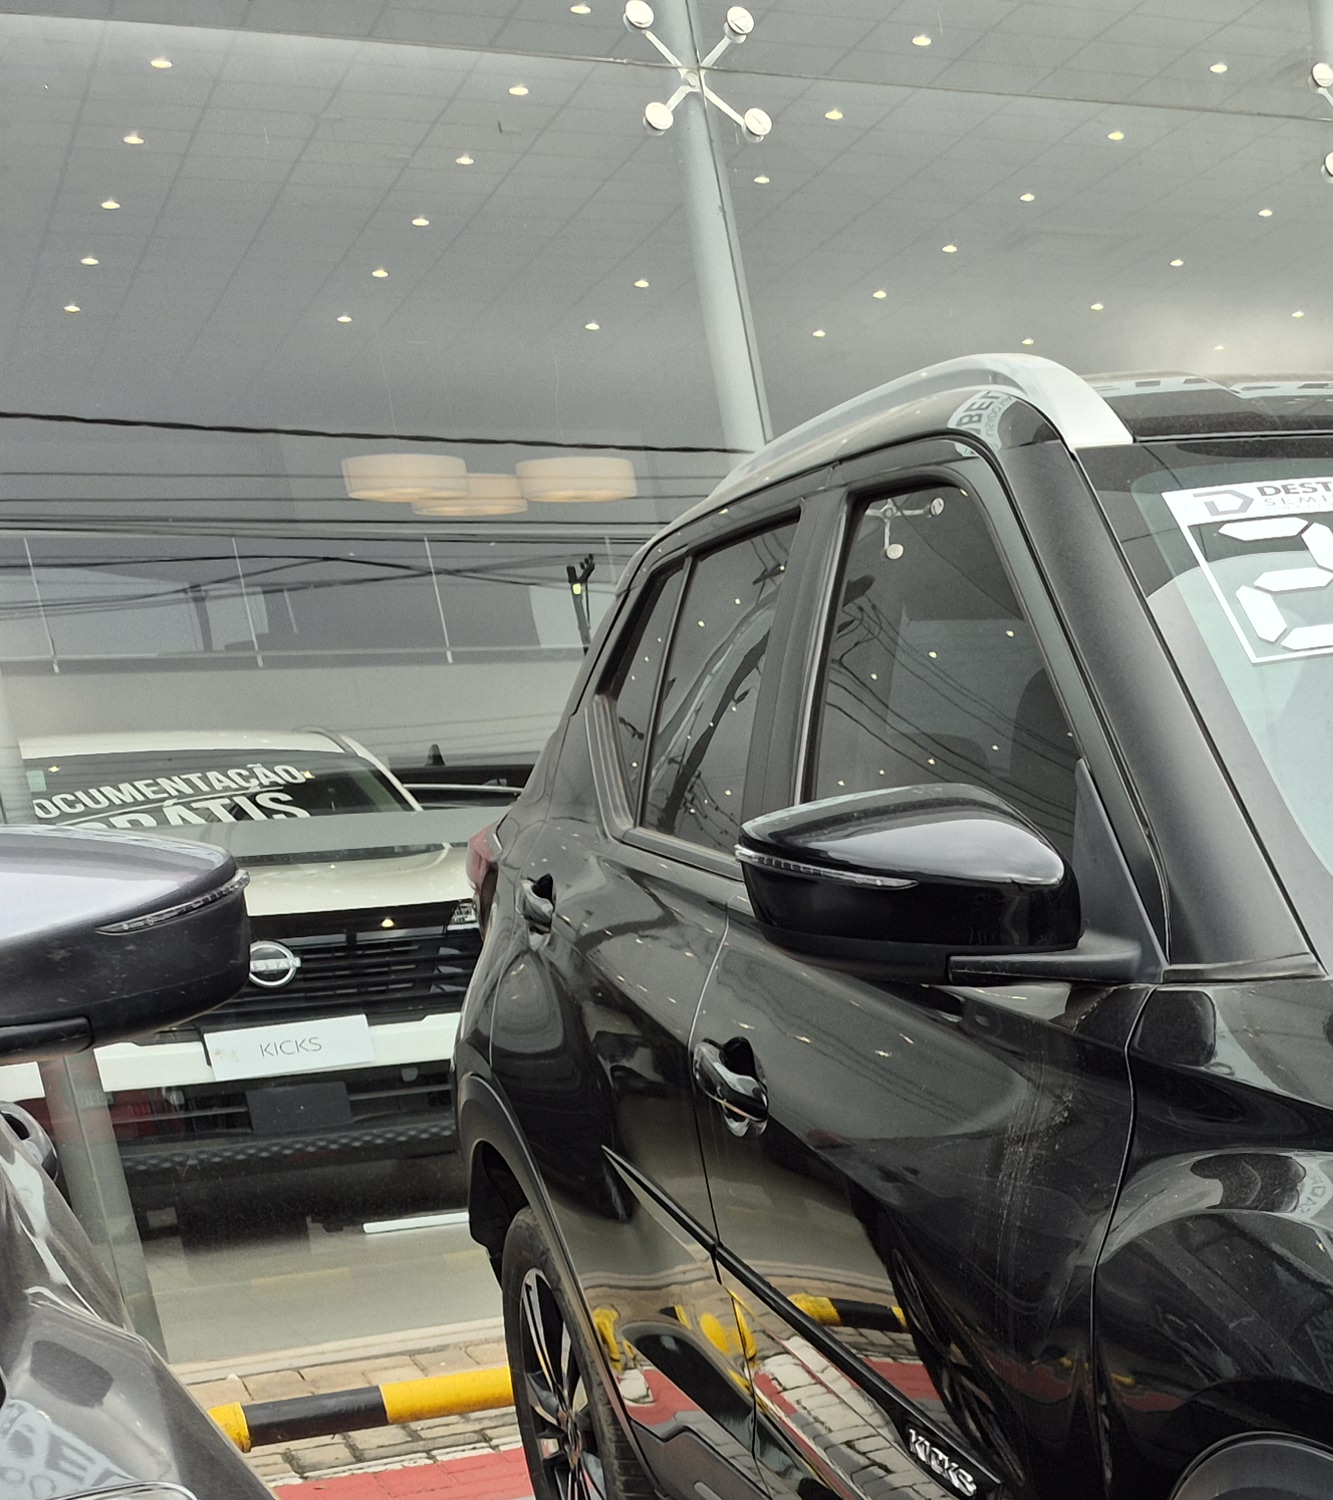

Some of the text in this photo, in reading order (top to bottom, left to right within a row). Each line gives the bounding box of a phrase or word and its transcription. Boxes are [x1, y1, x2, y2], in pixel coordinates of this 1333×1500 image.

[33, 763, 306, 819] OCUMENTAÇÃO
[260, 1036, 322, 1058] KICKS
[909, 1428, 977, 1497] KICKS
